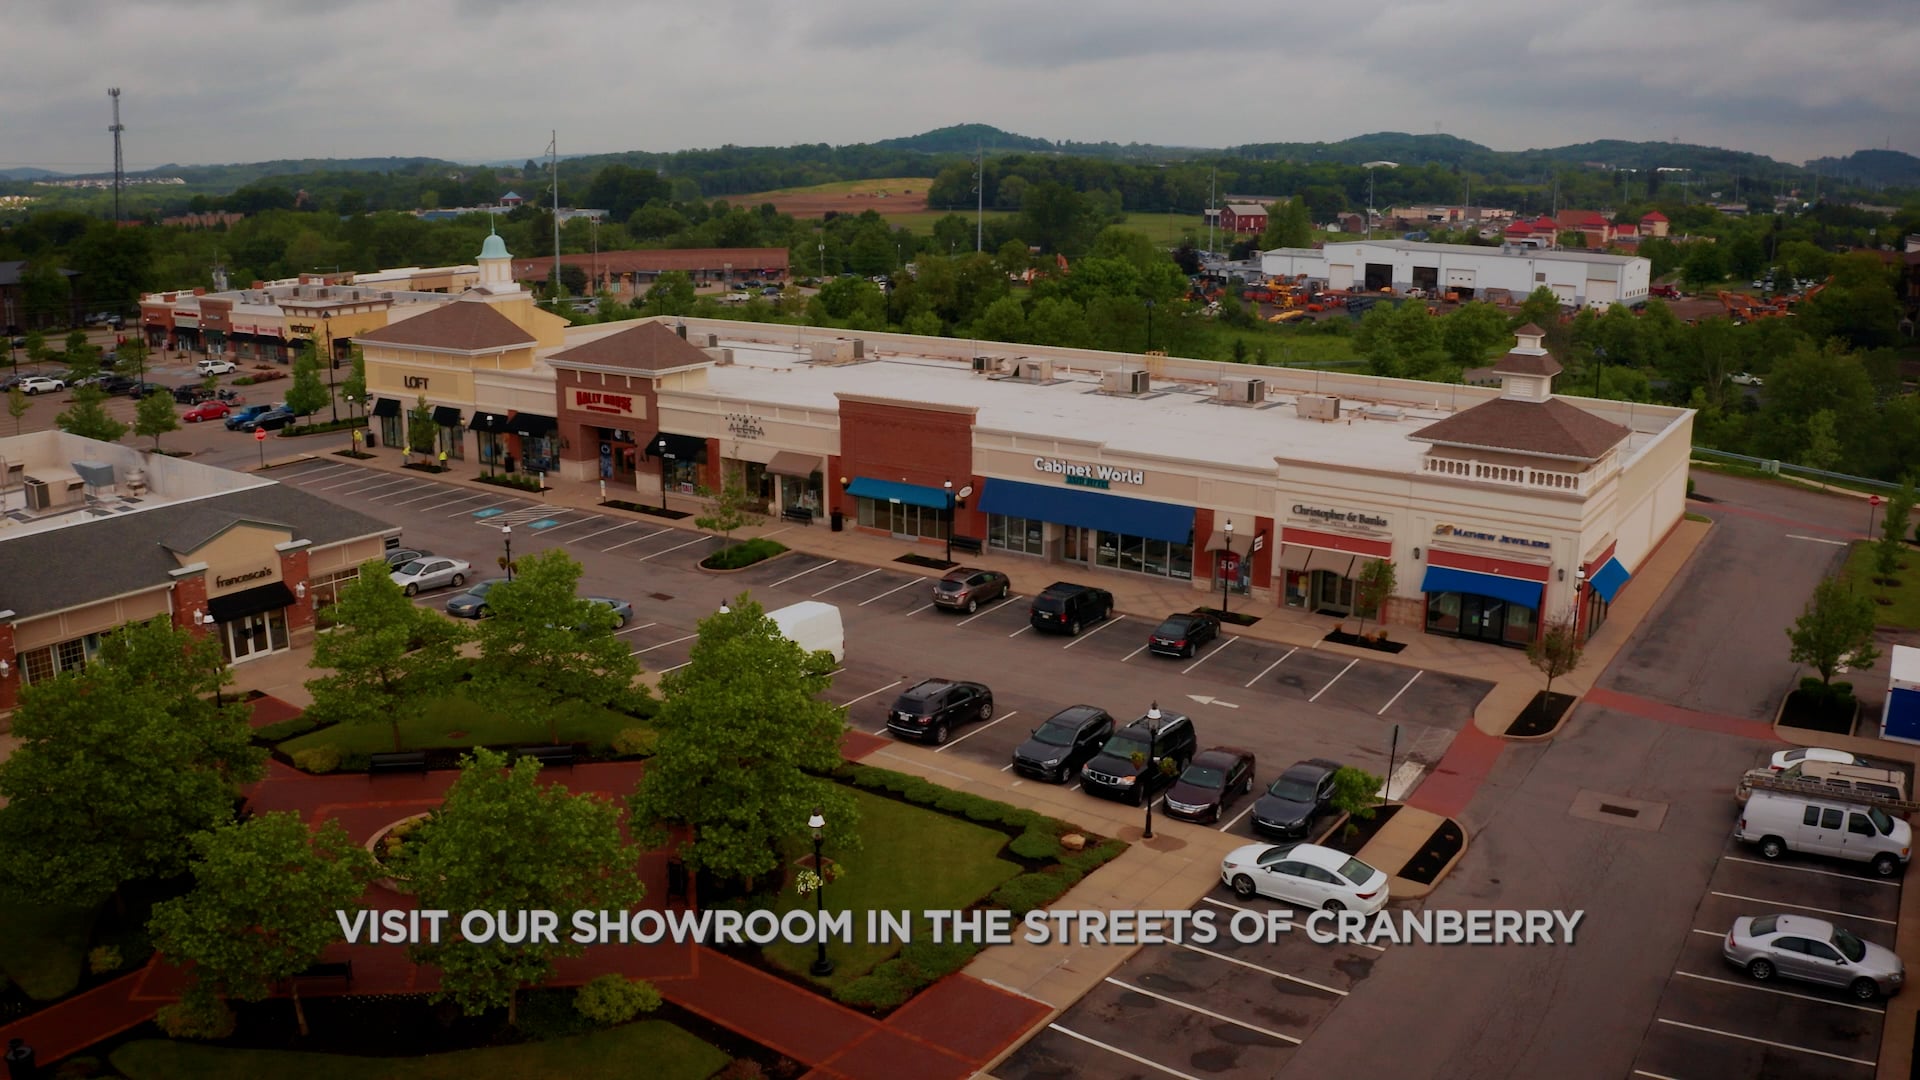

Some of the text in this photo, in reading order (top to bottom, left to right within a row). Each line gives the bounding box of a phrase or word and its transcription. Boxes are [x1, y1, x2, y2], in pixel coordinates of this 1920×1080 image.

[404, 375, 429, 390] LOFT
[1034, 457, 1092, 478] Cabinet
[1096, 465, 1144, 485] World
[1292, 504, 1345, 521] Christopher
[1346, 512, 1357, 523] &
[1358, 513, 1387, 526] Banks
[1453, 528, 1550, 549] MATHEW JEWELERS
[216, 567, 272, 588] francesca's
